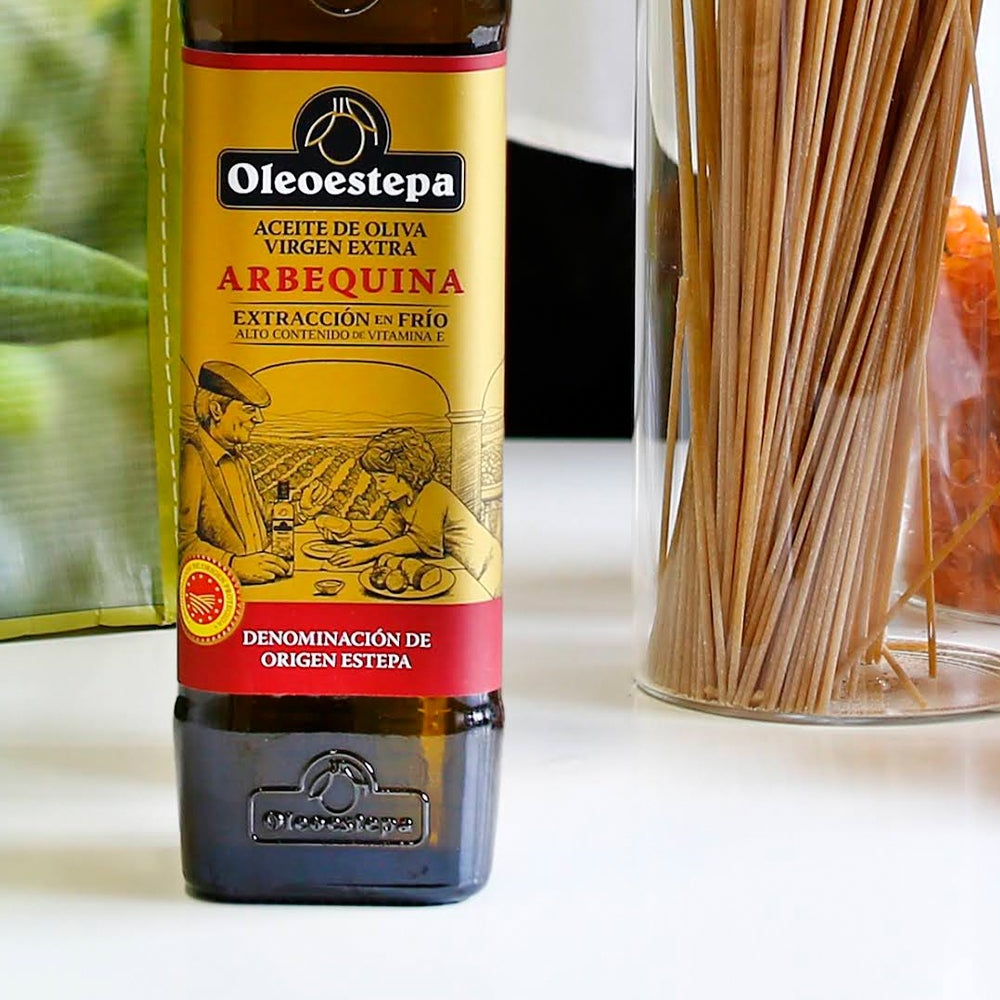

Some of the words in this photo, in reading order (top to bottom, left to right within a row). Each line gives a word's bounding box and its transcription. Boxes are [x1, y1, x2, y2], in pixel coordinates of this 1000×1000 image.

[227, 163, 455, 203] Oleoestepa
[254, 220, 327, 237] ACEITE
[333, 221, 360, 237] DE
[365, 221, 427, 238] OLIVA
[264, 239, 342, 256] VIRGEN
[347, 240, 417, 257] EXTRA
[217, 265, 465, 299] ARBEQUINA
[233, 307, 370, 327] EXTRACCIÓN
[375, 315, 393, 325] EN
[399, 309, 448, 328] FRÍO
[235, 329, 269, 339] ALTO
[272, 329, 350, 340] CONTENIDO
[353, 331, 366, 339] DE
[368, 330, 432, 342] VITAMINA
[437, 332, 445, 342] E
[242, 628, 401, 648] DENOMINACIÓN
[405, 631, 432, 648] DE
[260, 652, 337, 668] ORIGEN
[341, 653, 412, 669] ESTEPA
